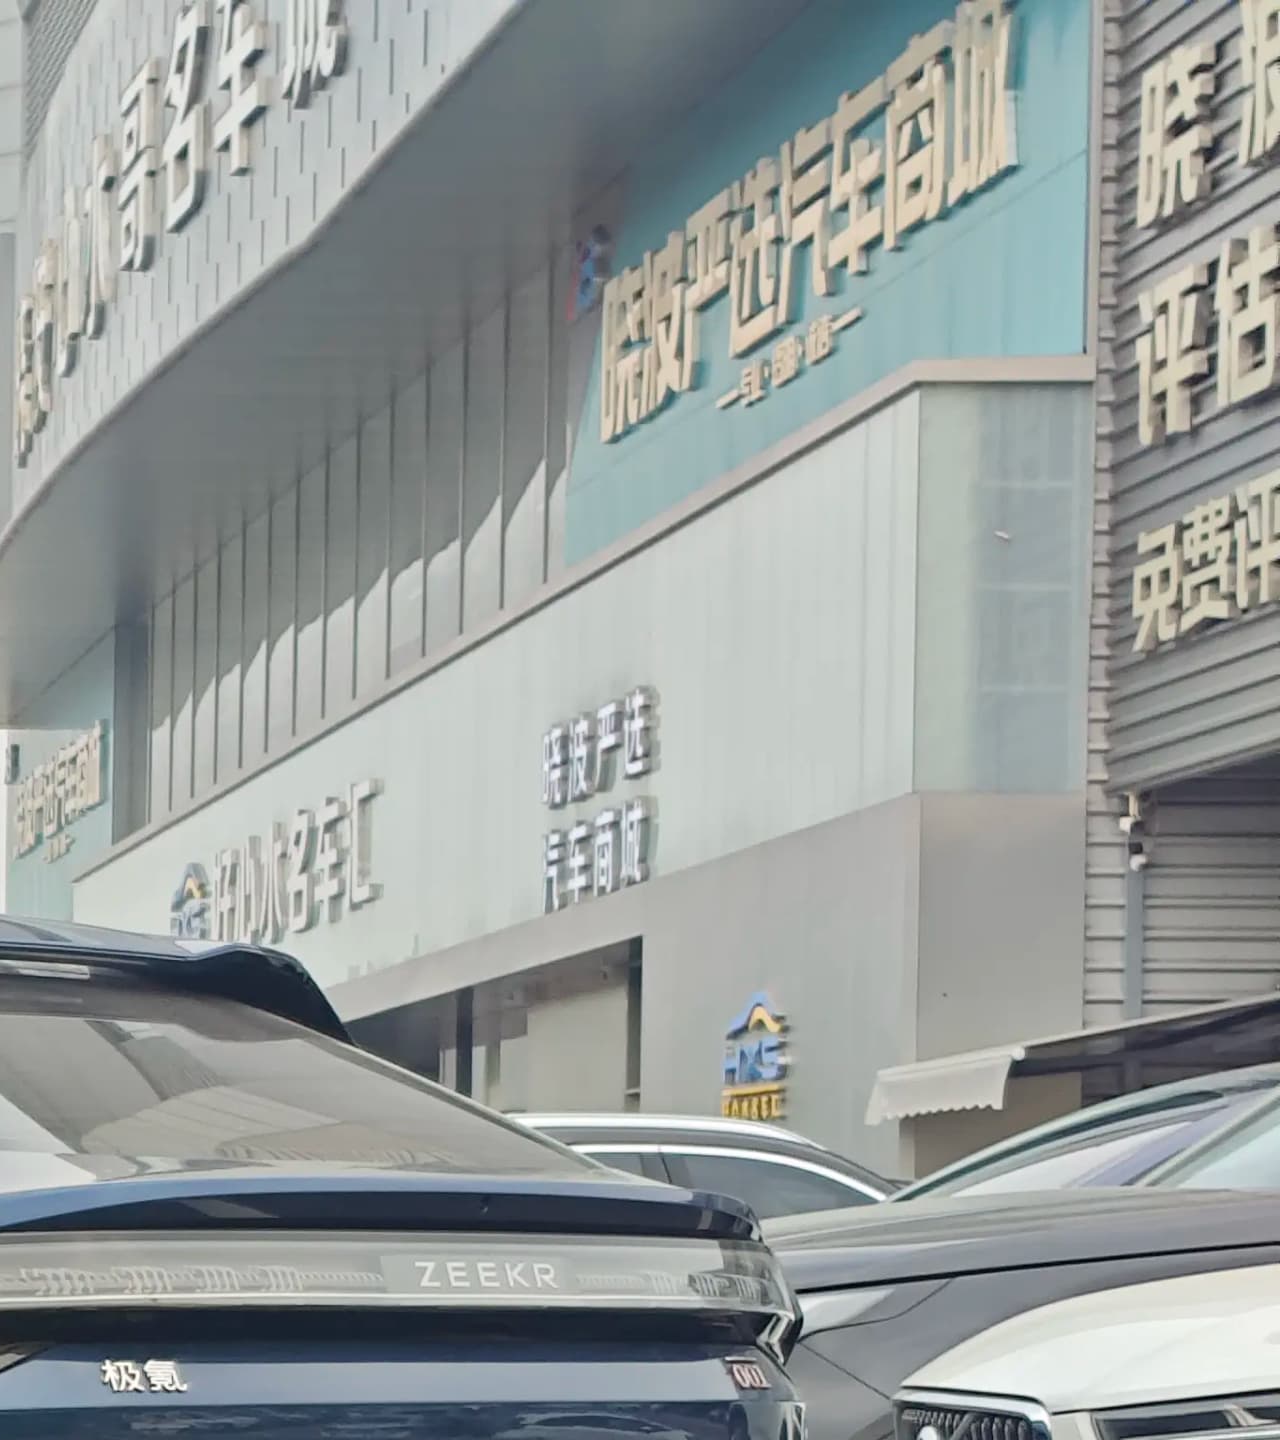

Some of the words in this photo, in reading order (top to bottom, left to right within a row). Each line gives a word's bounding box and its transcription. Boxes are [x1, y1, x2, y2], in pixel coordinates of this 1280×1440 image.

[600, 0, 1010, 443] 晓波严选汽车商城
[1137, 224, 1280, 447] 评估
[543, 687, 648, 806] 晓波严选
[543, 799, 646, 914] 汽车商城
[414, 1261, 558, 1289] ZEEKR
[101, 1359, 188, 1393] 极氪
[731, 1364, 771, 1390] 001
